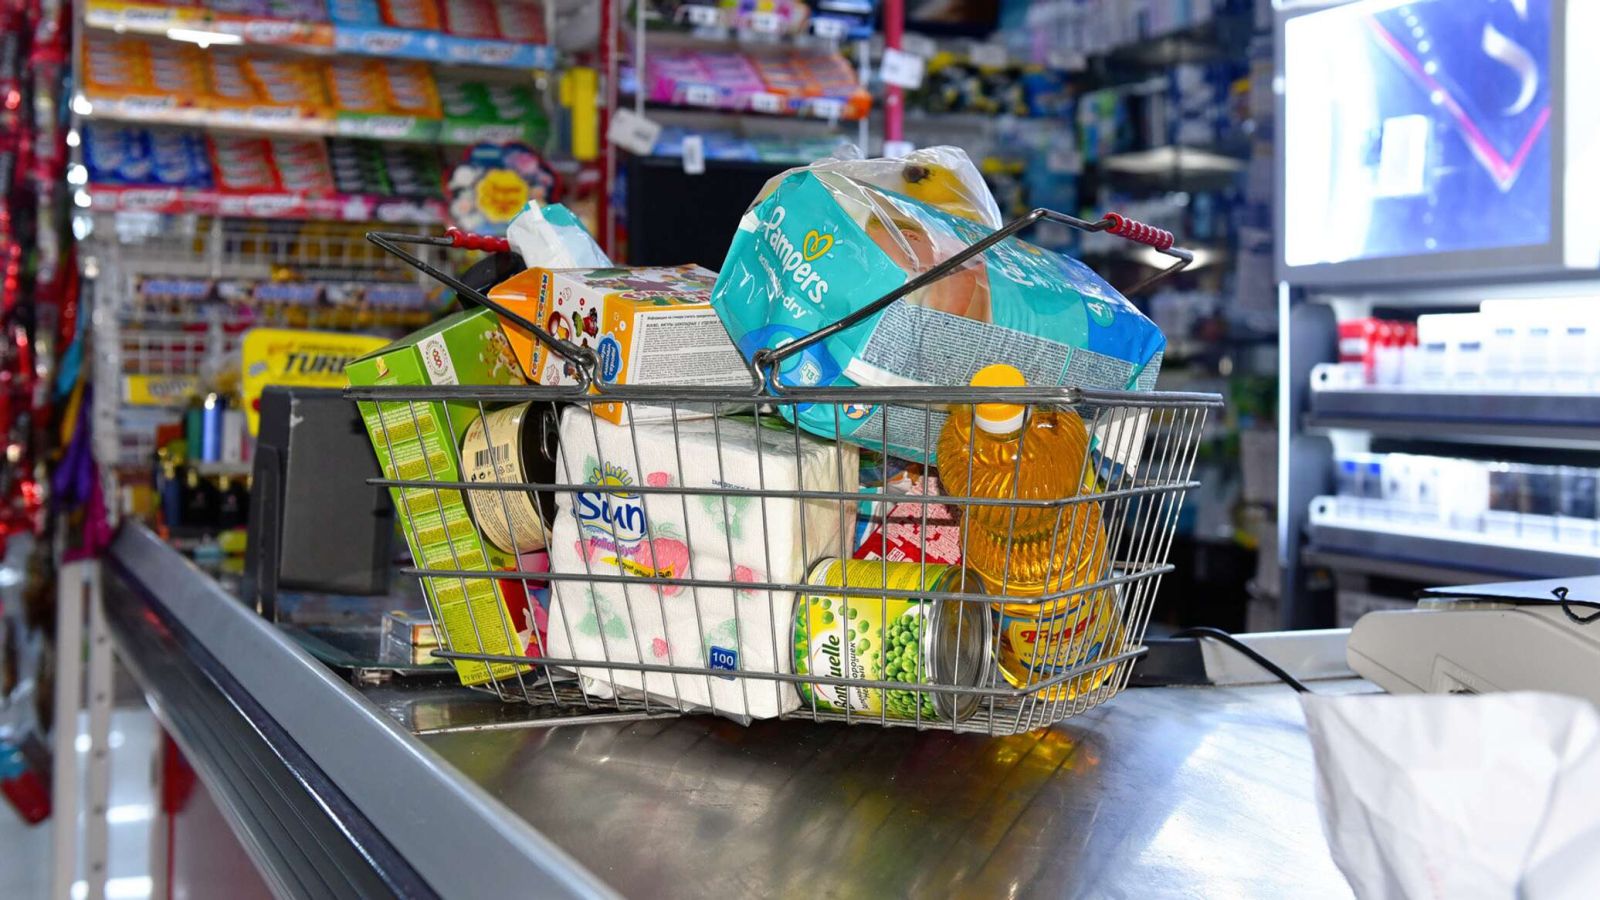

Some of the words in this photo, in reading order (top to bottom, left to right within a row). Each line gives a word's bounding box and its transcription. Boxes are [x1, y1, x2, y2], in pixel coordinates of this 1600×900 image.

[762, 205, 828, 304] Pampers
[572, 490, 646, 534] Sun
[712, 651, 734, 666] 100
[821, 634, 854, 712] Bonuelle
